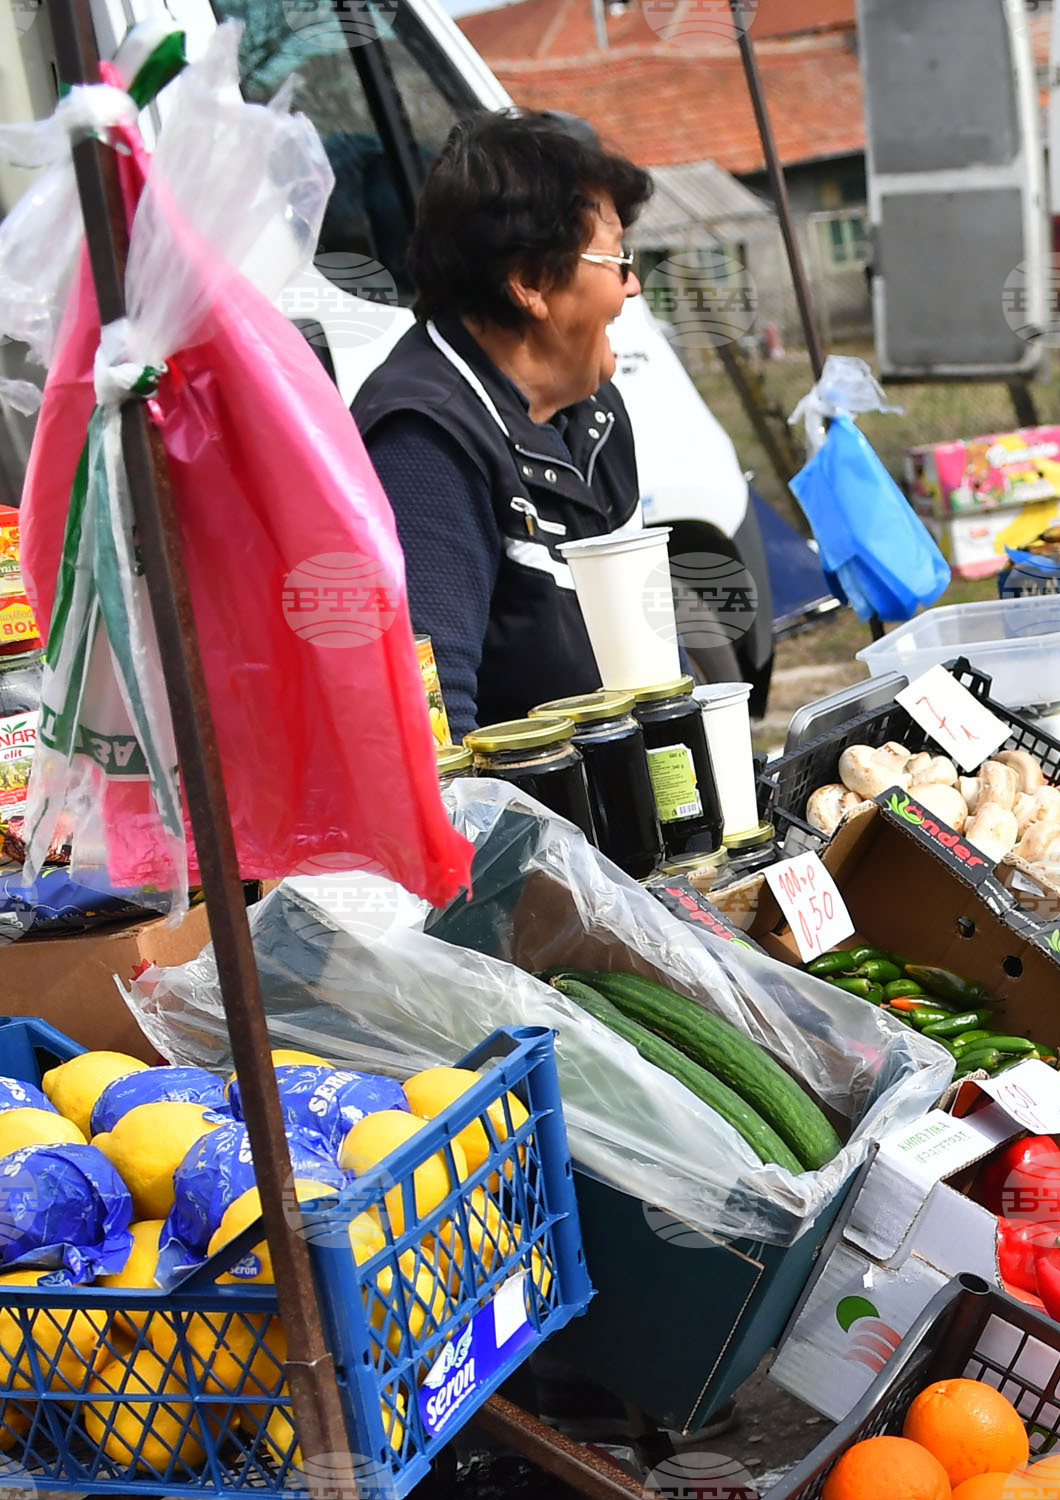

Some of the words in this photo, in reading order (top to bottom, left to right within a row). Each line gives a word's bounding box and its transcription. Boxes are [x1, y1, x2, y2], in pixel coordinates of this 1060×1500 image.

[4, 749, 22, 760] elit
[664, 886, 735, 941] nder
[426, 1358, 476, 1425] seron
